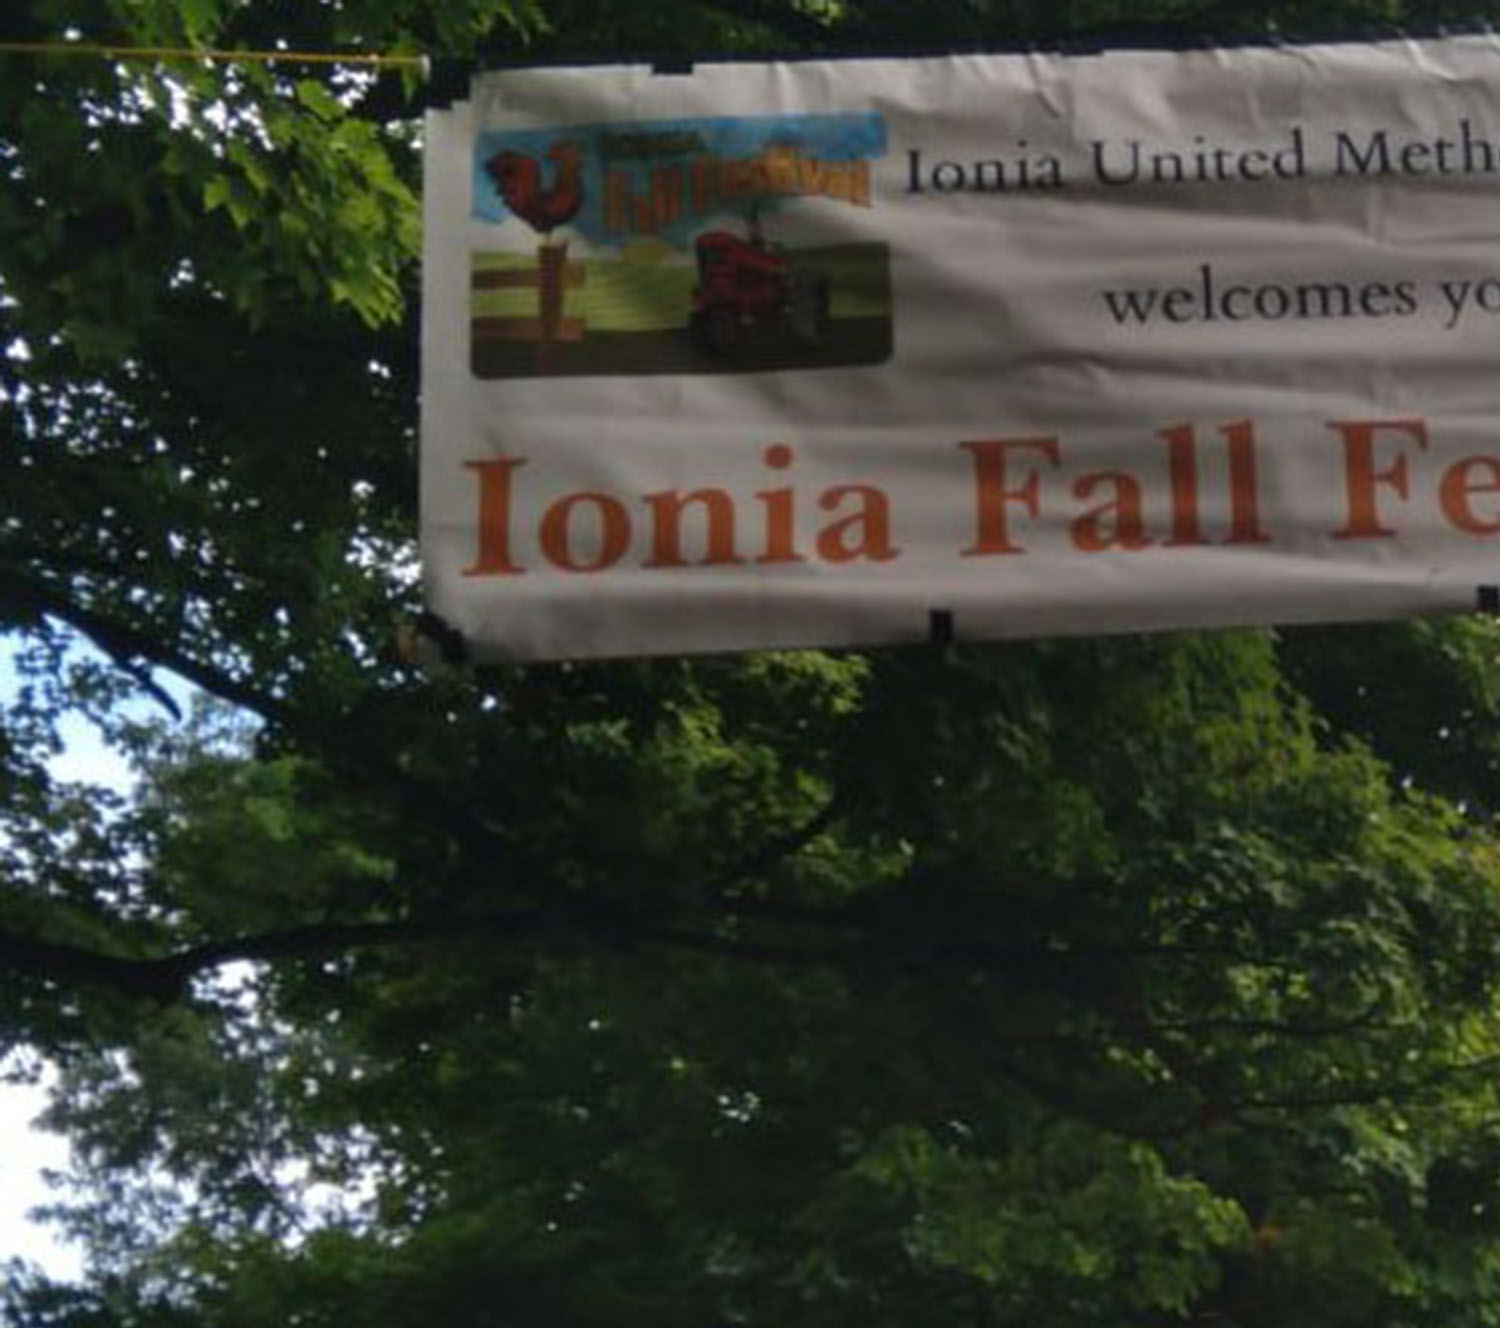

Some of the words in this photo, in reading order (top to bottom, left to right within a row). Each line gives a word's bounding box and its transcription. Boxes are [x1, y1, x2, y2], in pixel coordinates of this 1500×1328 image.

[905, 138, 1066, 197] Ionia
[1091, 127, 1306, 187] United
[1102, 263, 1418, 325] welcomes
[461, 443, 900, 579] Ionia
[958, 419, 1270, 558] Fall
